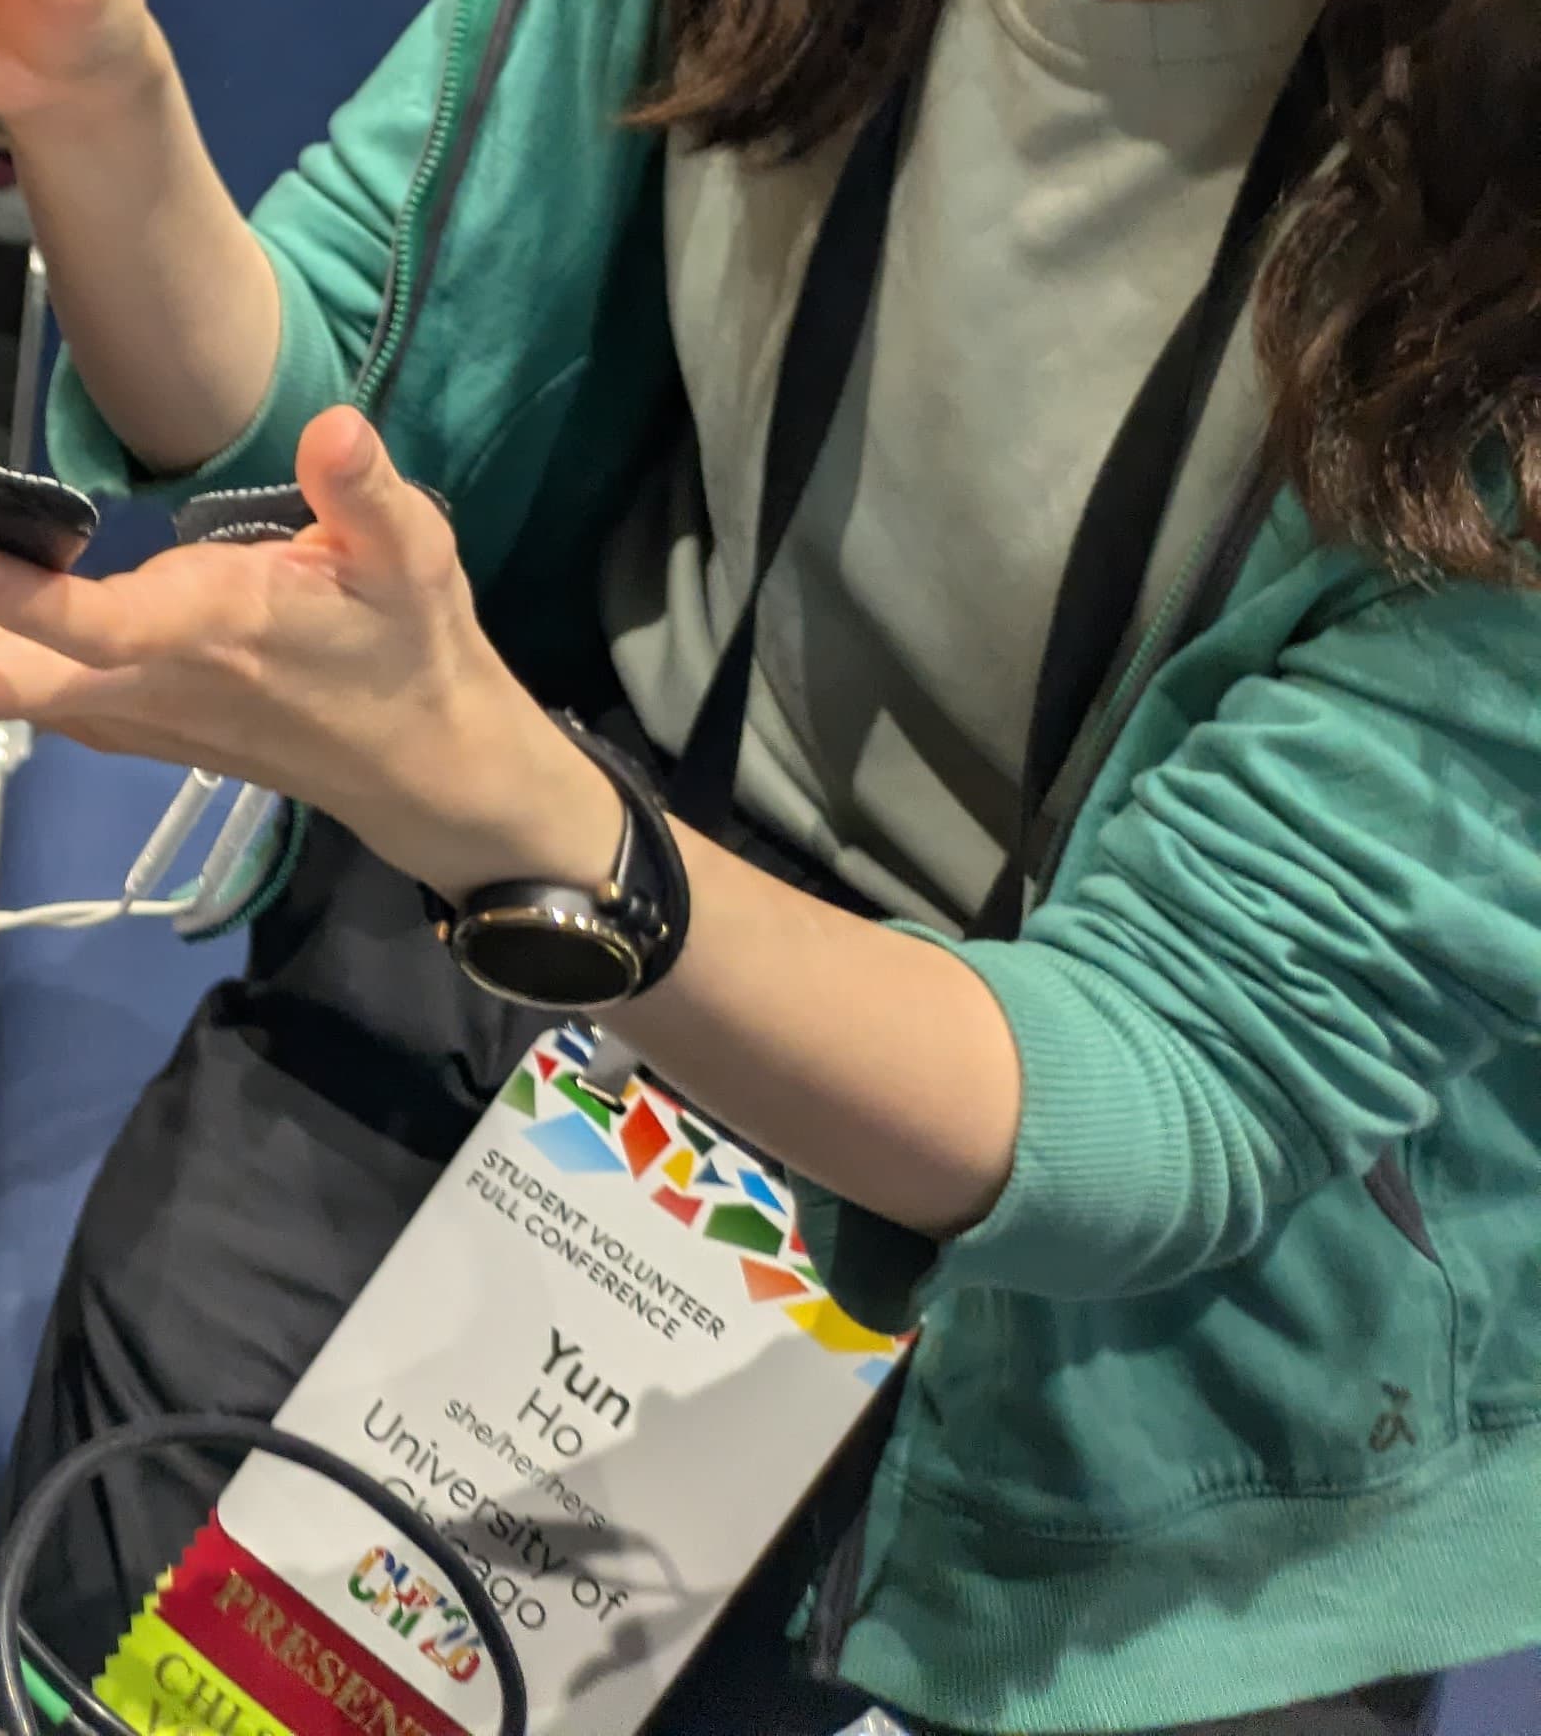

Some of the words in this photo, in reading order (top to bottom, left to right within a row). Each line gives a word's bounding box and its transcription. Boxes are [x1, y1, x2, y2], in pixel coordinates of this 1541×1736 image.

[465, 1169, 519, 1222] FULL
[524, 1212, 681, 1342] CONFERENCE
[481, 1148, 588, 1234] STUDENT
[591, 1223, 726, 1340] VOLUNTEER
[516, 1386, 584, 1459] Ho
[540, 1326, 631, 1428] Yun
[363, 1397, 568, 1579] University
[572, 1574, 629, 1622] of
